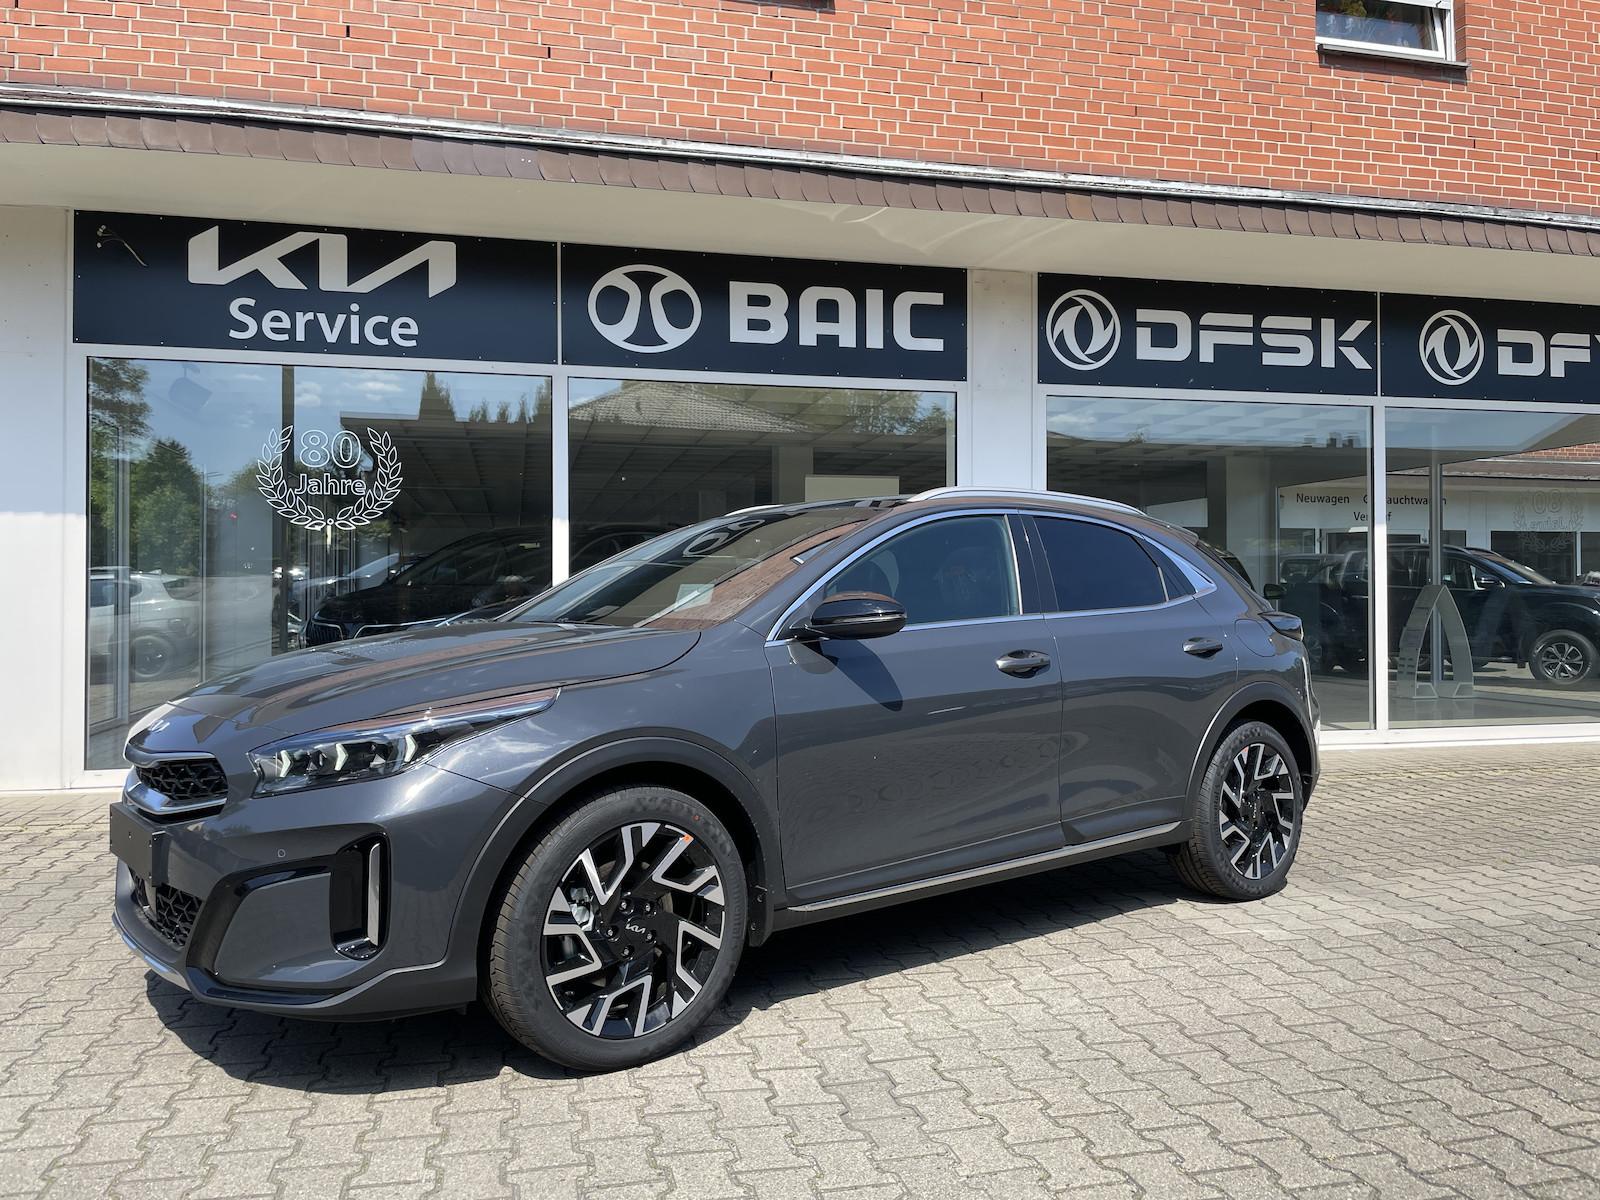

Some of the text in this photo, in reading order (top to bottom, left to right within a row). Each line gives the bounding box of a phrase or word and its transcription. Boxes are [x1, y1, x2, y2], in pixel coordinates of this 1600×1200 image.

[187, 225, 457, 298] KIA
[228, 297, 419, 347] Service
[728, 280, 944, 352] BAIC
[1135, 308, 1373, 371] DFSK
[1497, 328, 1600, 378] DF
[298, 429, 362, 468] 80
[294, 473, 366, 496] Jahre
[1296, 492, 1447, 506] Neuwagen Gauchtwan
